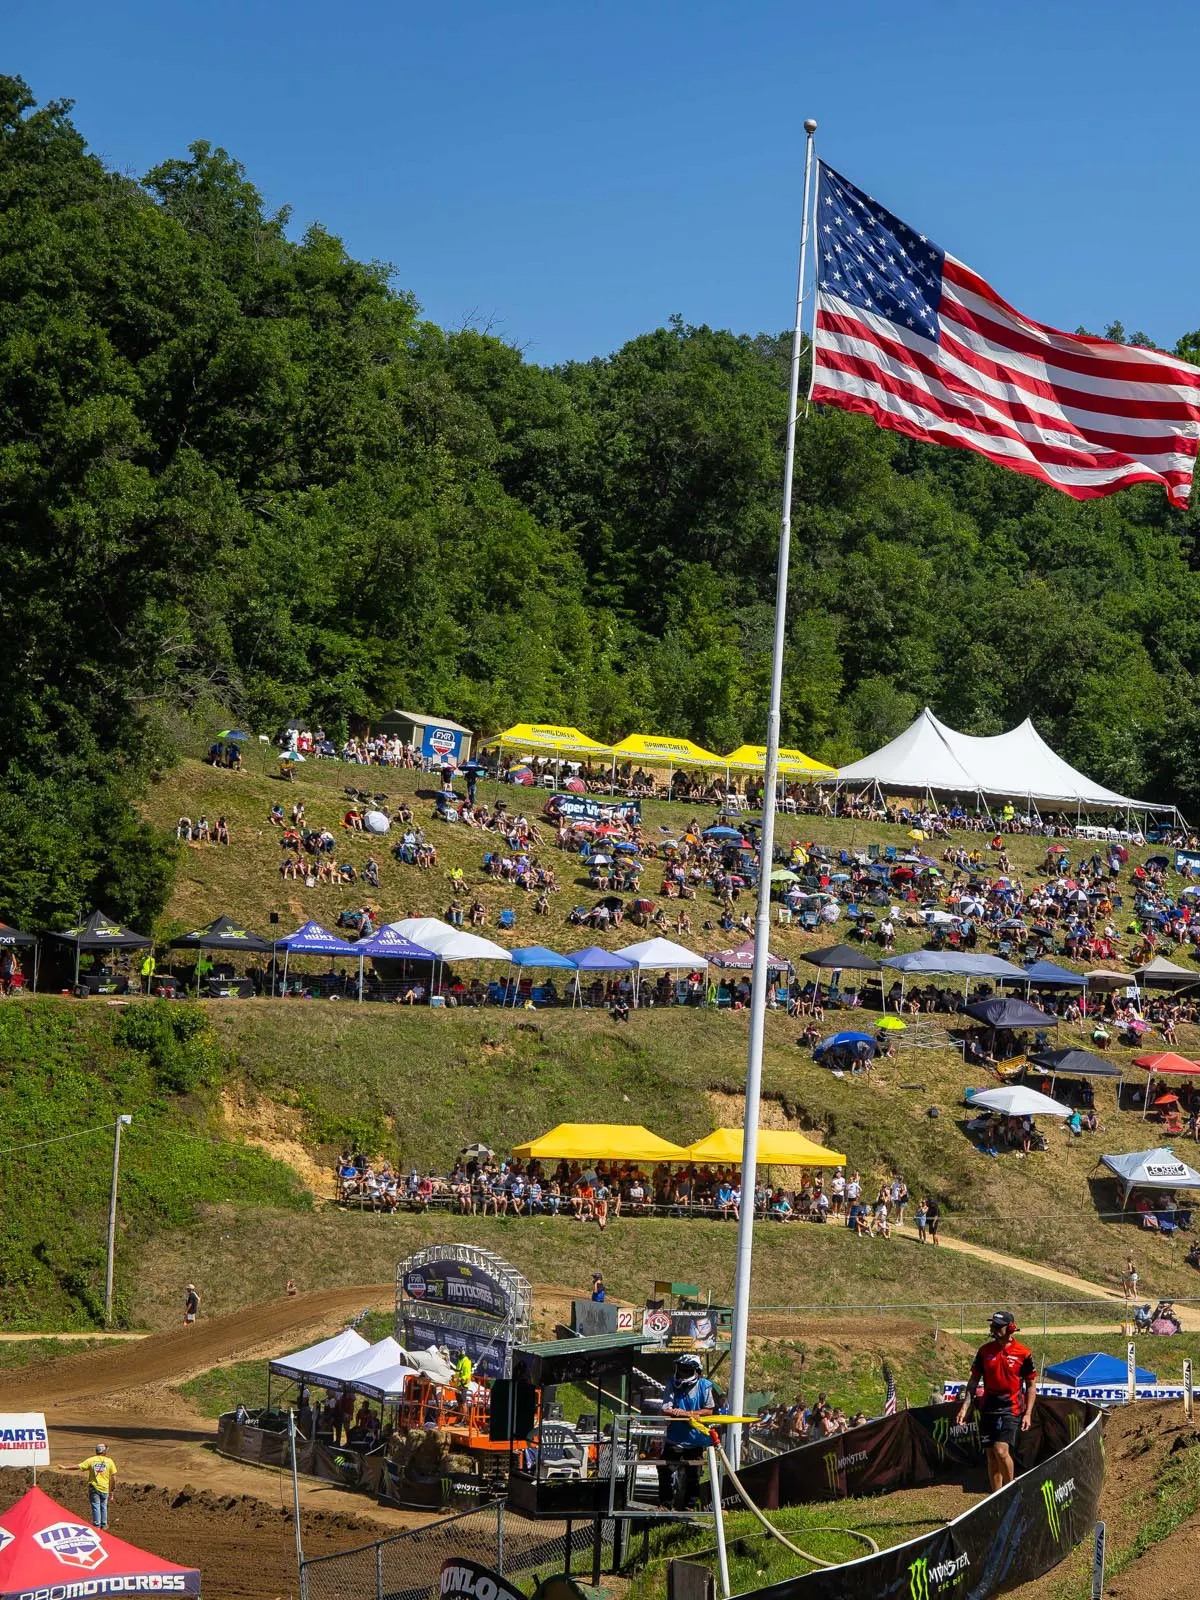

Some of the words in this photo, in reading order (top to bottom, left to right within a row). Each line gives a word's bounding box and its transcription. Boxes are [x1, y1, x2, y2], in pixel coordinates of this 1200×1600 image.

[436, 731, 452, 740] FXR
[619, 1313, 632, 1328] 22
[1066, 1388, 1125, 1399] PARTS
[0, 1442, 46, 1450] NLIMITED
[838, 1450, 869, 1470] MONSTER
[1055, 1477, 1076, 1503] MONSTER
[41, 1526, 93, 1544] MX
[928, 1551, 971, 1583] MONSTER
[441, 1566, 520, 1600] UNLO
